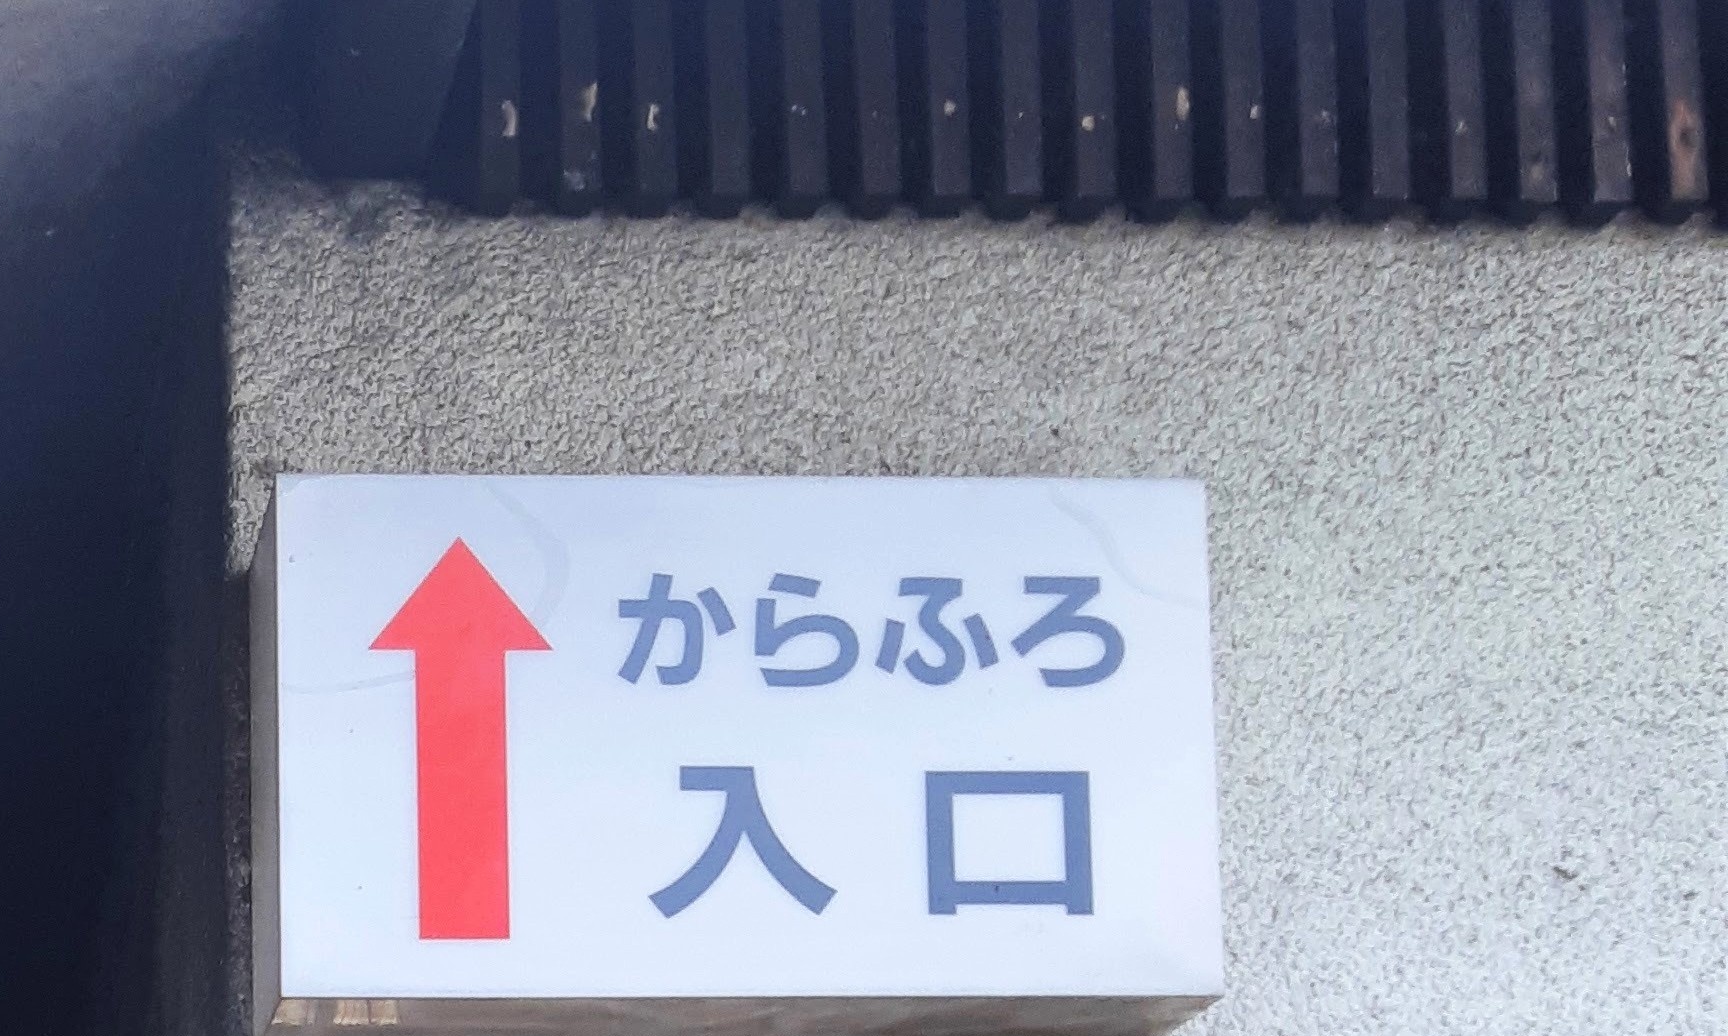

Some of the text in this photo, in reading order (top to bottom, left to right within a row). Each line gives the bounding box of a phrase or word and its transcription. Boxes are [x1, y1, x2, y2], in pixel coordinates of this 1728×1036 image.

[617, 572, 1126, 688] からふろ
[648, 765, 1094, 919] 入口
